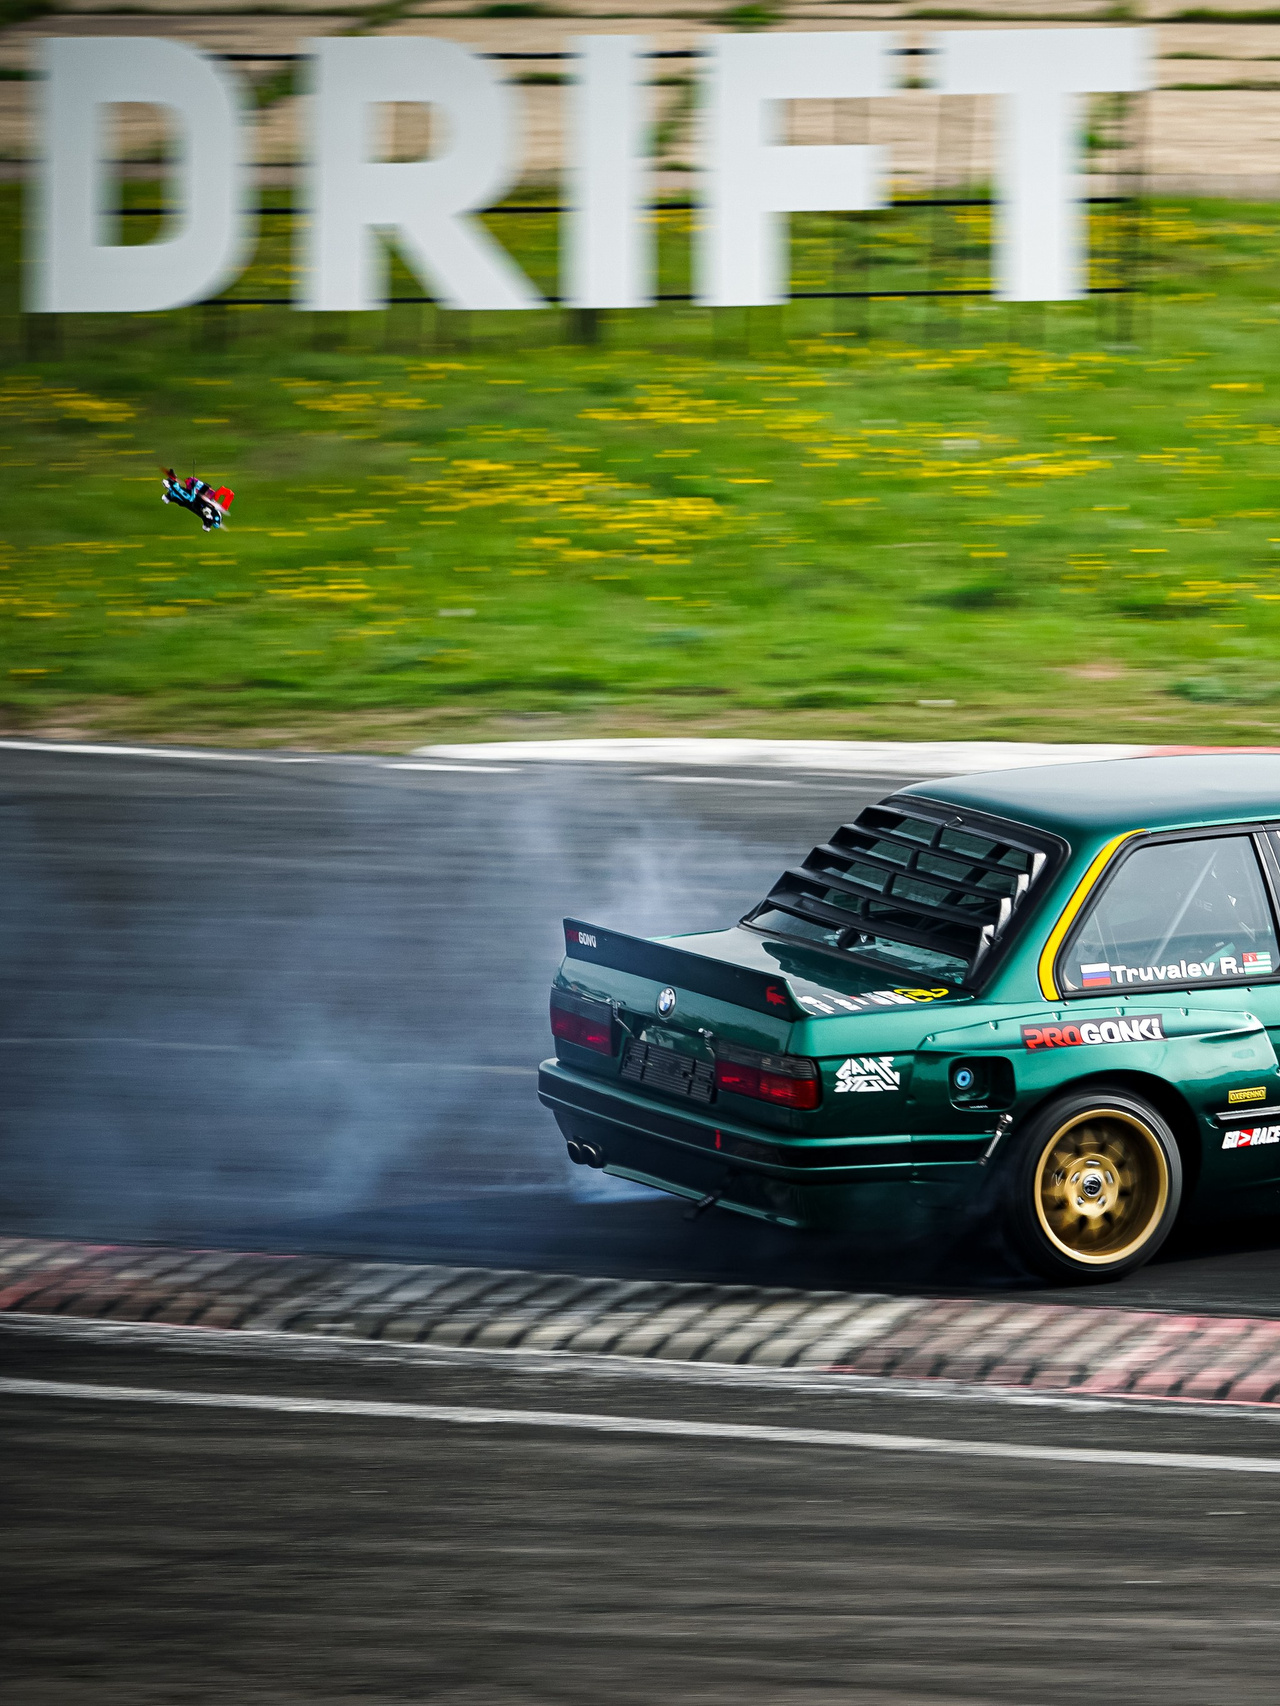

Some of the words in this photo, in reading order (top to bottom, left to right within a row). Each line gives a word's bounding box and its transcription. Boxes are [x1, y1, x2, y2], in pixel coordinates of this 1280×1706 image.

[27, 27, 1150, 312] DRIFT
[1110, 959, 1215, 983] Truvalev
[1219, 956, 1245, 975] R.
[835, 1056, 901, 1085] GAME
